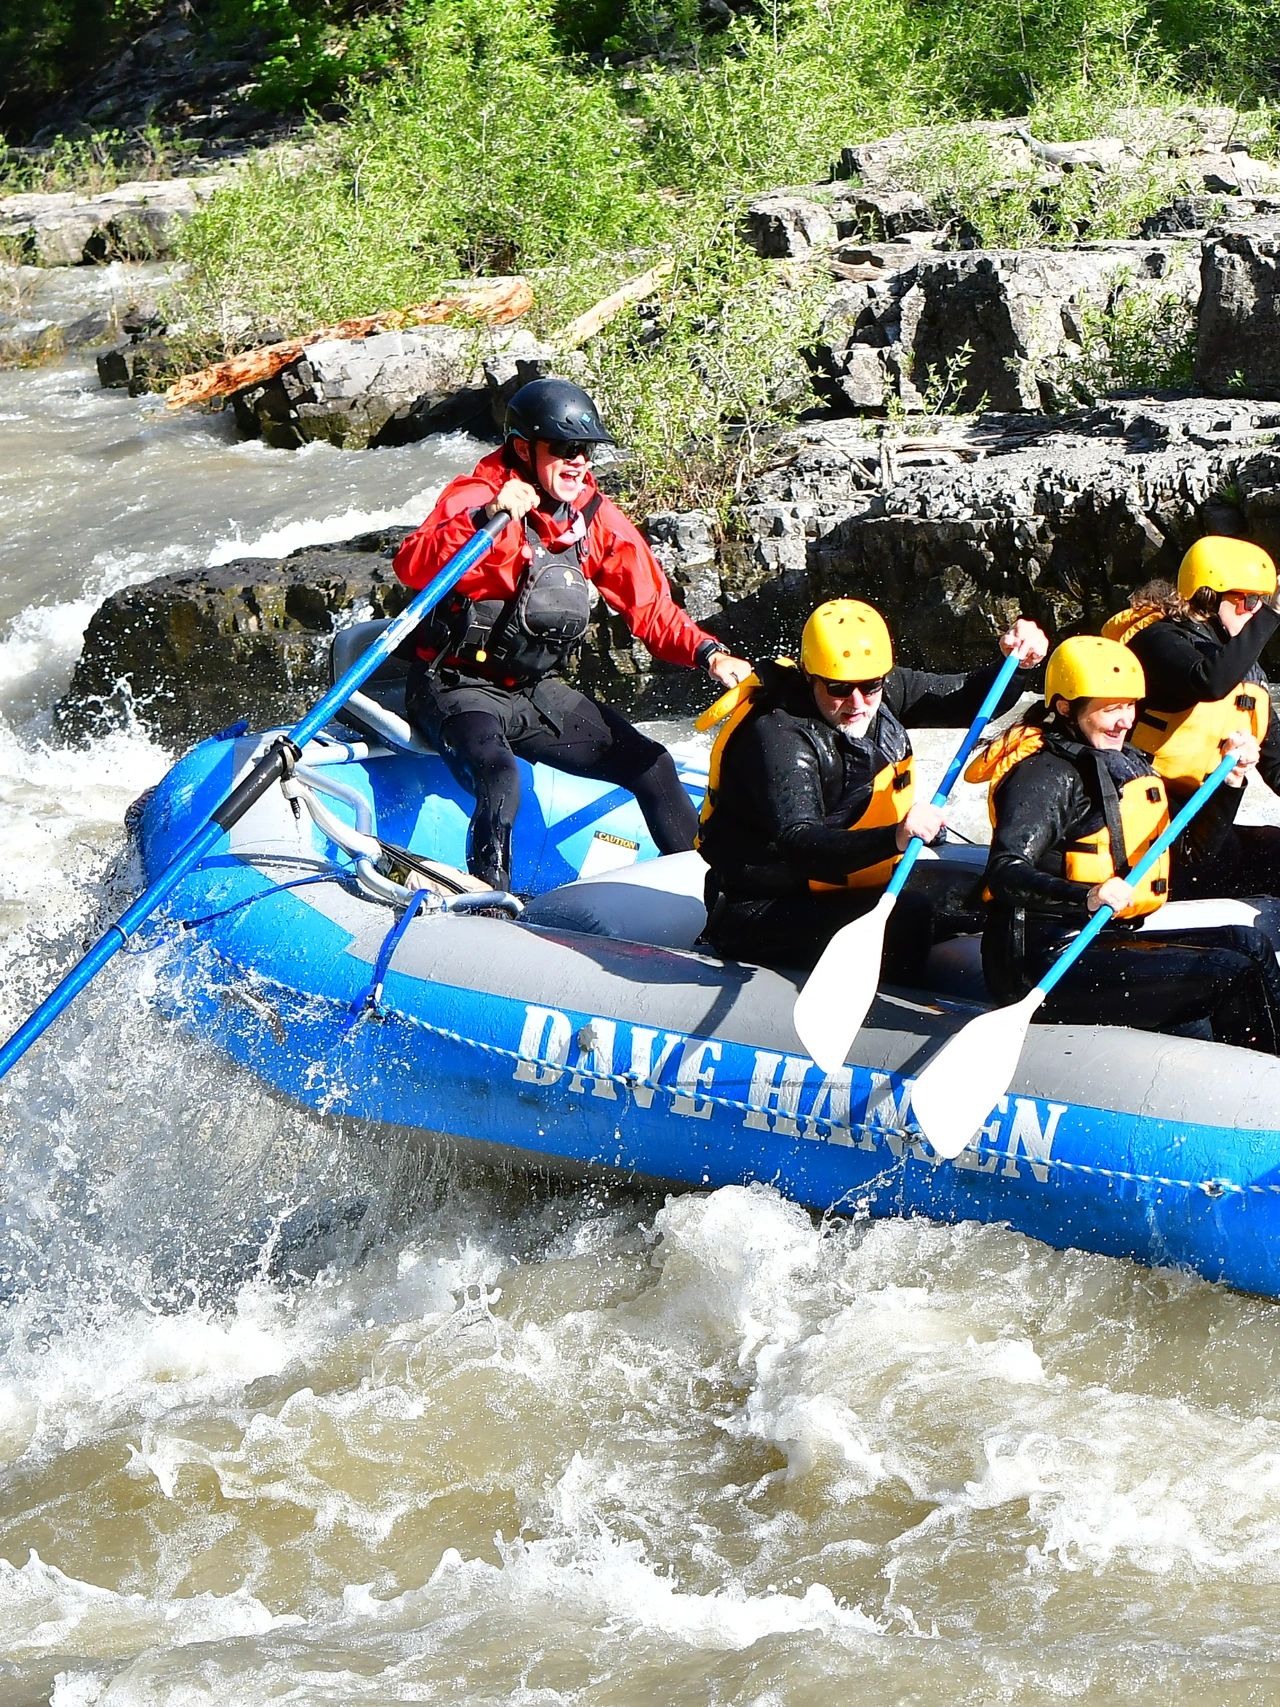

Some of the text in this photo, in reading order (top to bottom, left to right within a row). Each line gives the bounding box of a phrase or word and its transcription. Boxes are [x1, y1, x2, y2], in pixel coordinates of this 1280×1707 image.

[598, 832, 637, 850] CAUTION
[512, 1003, 1068, 1184] DAVE HANEN
